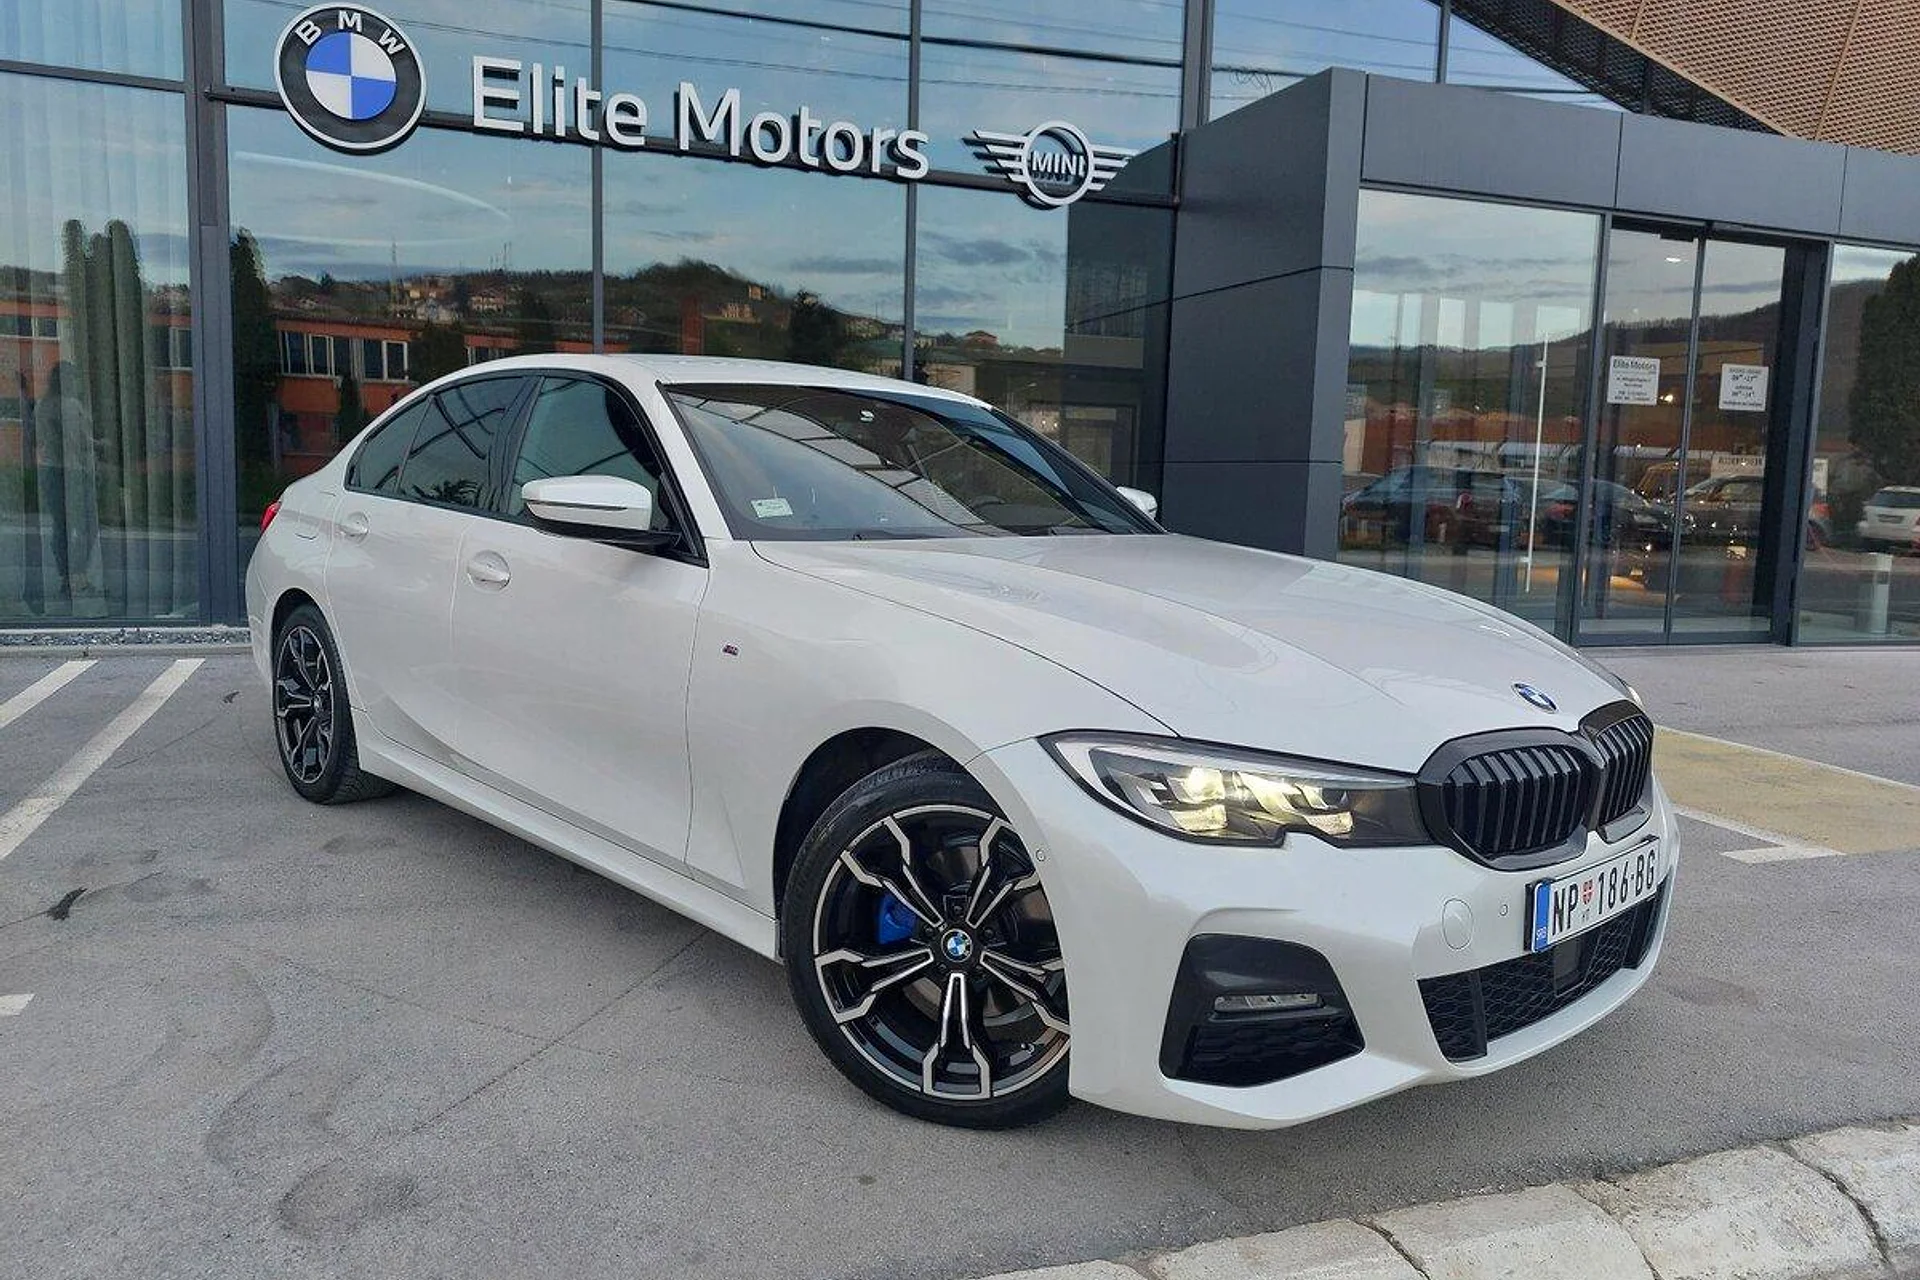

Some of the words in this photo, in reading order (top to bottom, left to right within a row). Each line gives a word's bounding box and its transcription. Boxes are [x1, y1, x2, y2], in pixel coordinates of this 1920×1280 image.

[295, 10, 406, 55] BMW
[473, 56, 648, 146] Elite
[678, 81, 930, 179] Motors
[1032, 151, 1086, 177] MINI
[1551, 883, 1579, 936] NP
